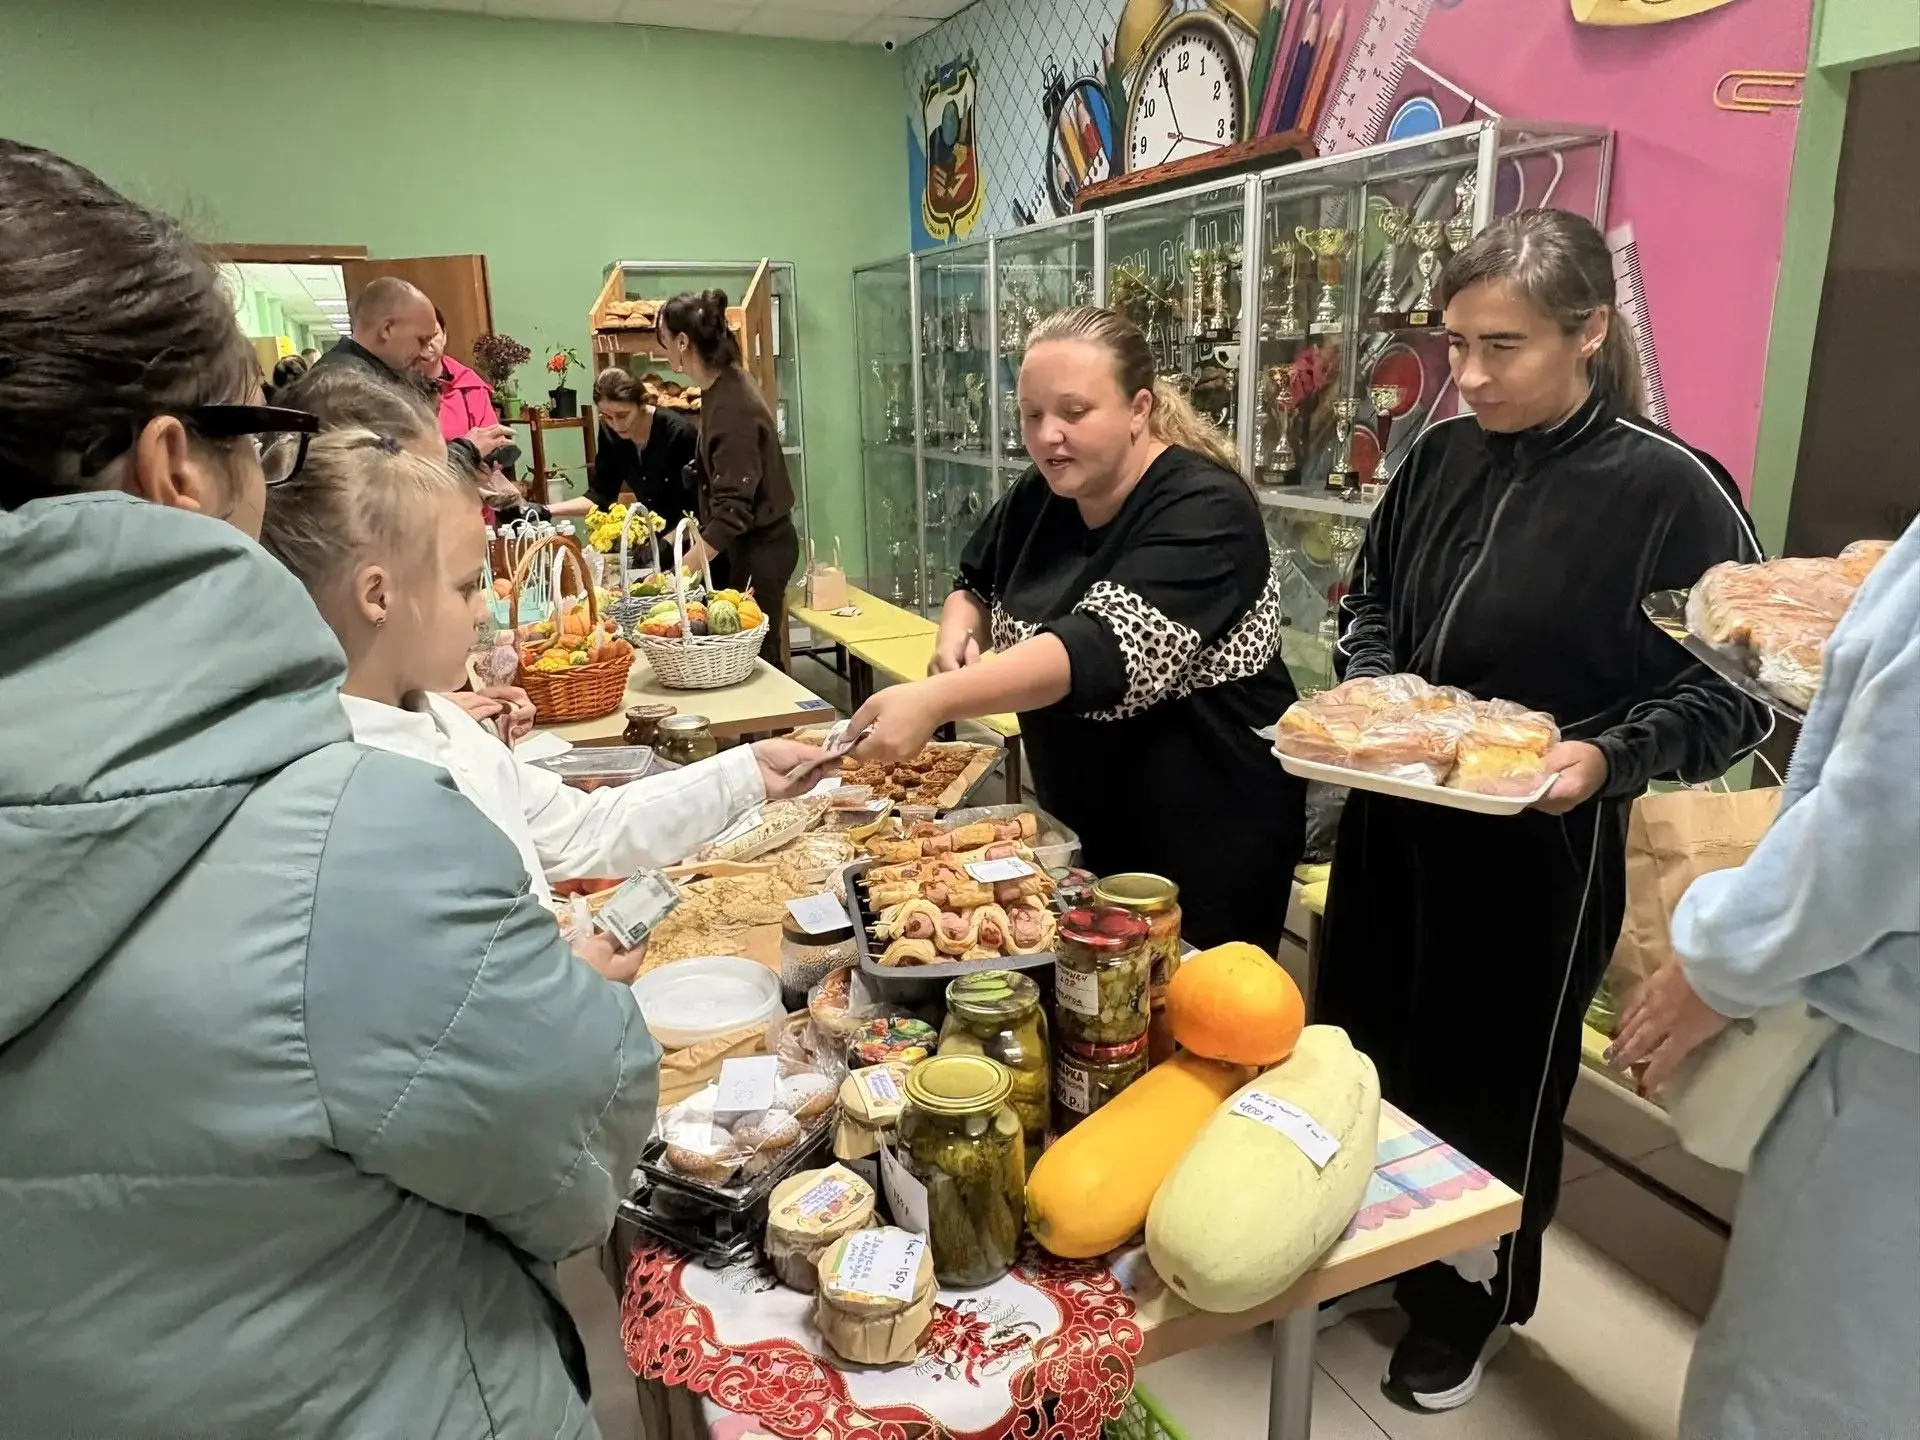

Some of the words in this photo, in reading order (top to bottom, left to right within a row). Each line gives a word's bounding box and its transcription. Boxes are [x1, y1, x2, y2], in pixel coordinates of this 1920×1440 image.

[1177, 51, 1190, 73] 12
[1200, 56, 1206, 77] 1
[1213, 80, 1221, 101] 2
[1144, 98, 1156, 119] 10
[1217, 118, 1225, 139] 3
[1141, 136, 1147, 155] 9
[1240, 1102, 1263, 1115] 400
